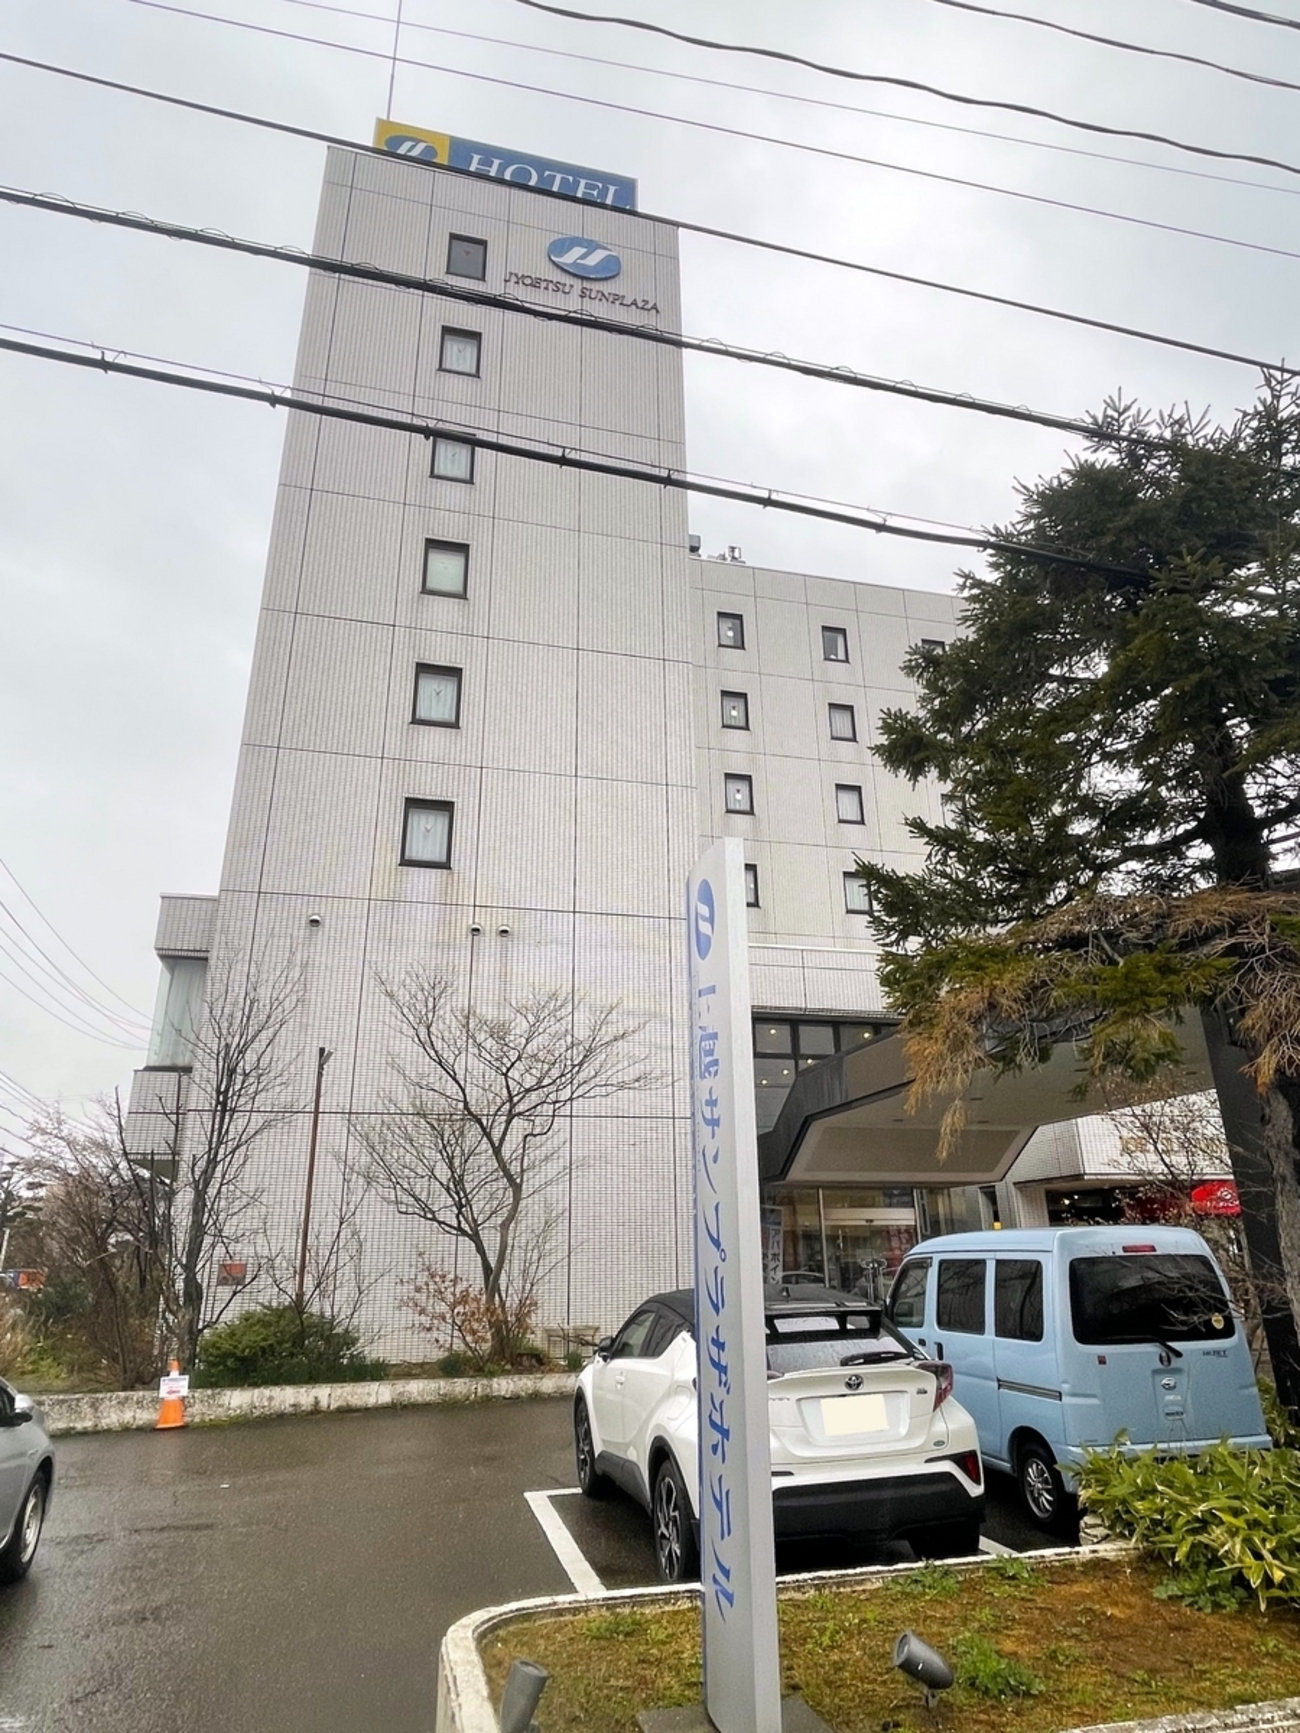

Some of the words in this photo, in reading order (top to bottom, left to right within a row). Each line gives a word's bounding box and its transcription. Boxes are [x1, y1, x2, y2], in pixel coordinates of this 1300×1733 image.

[469, 153, 631, 210] HOTEL
[504, 271, 574, 295] JYOETSU
[578, 287, 660, 314] SUNPLAZA
